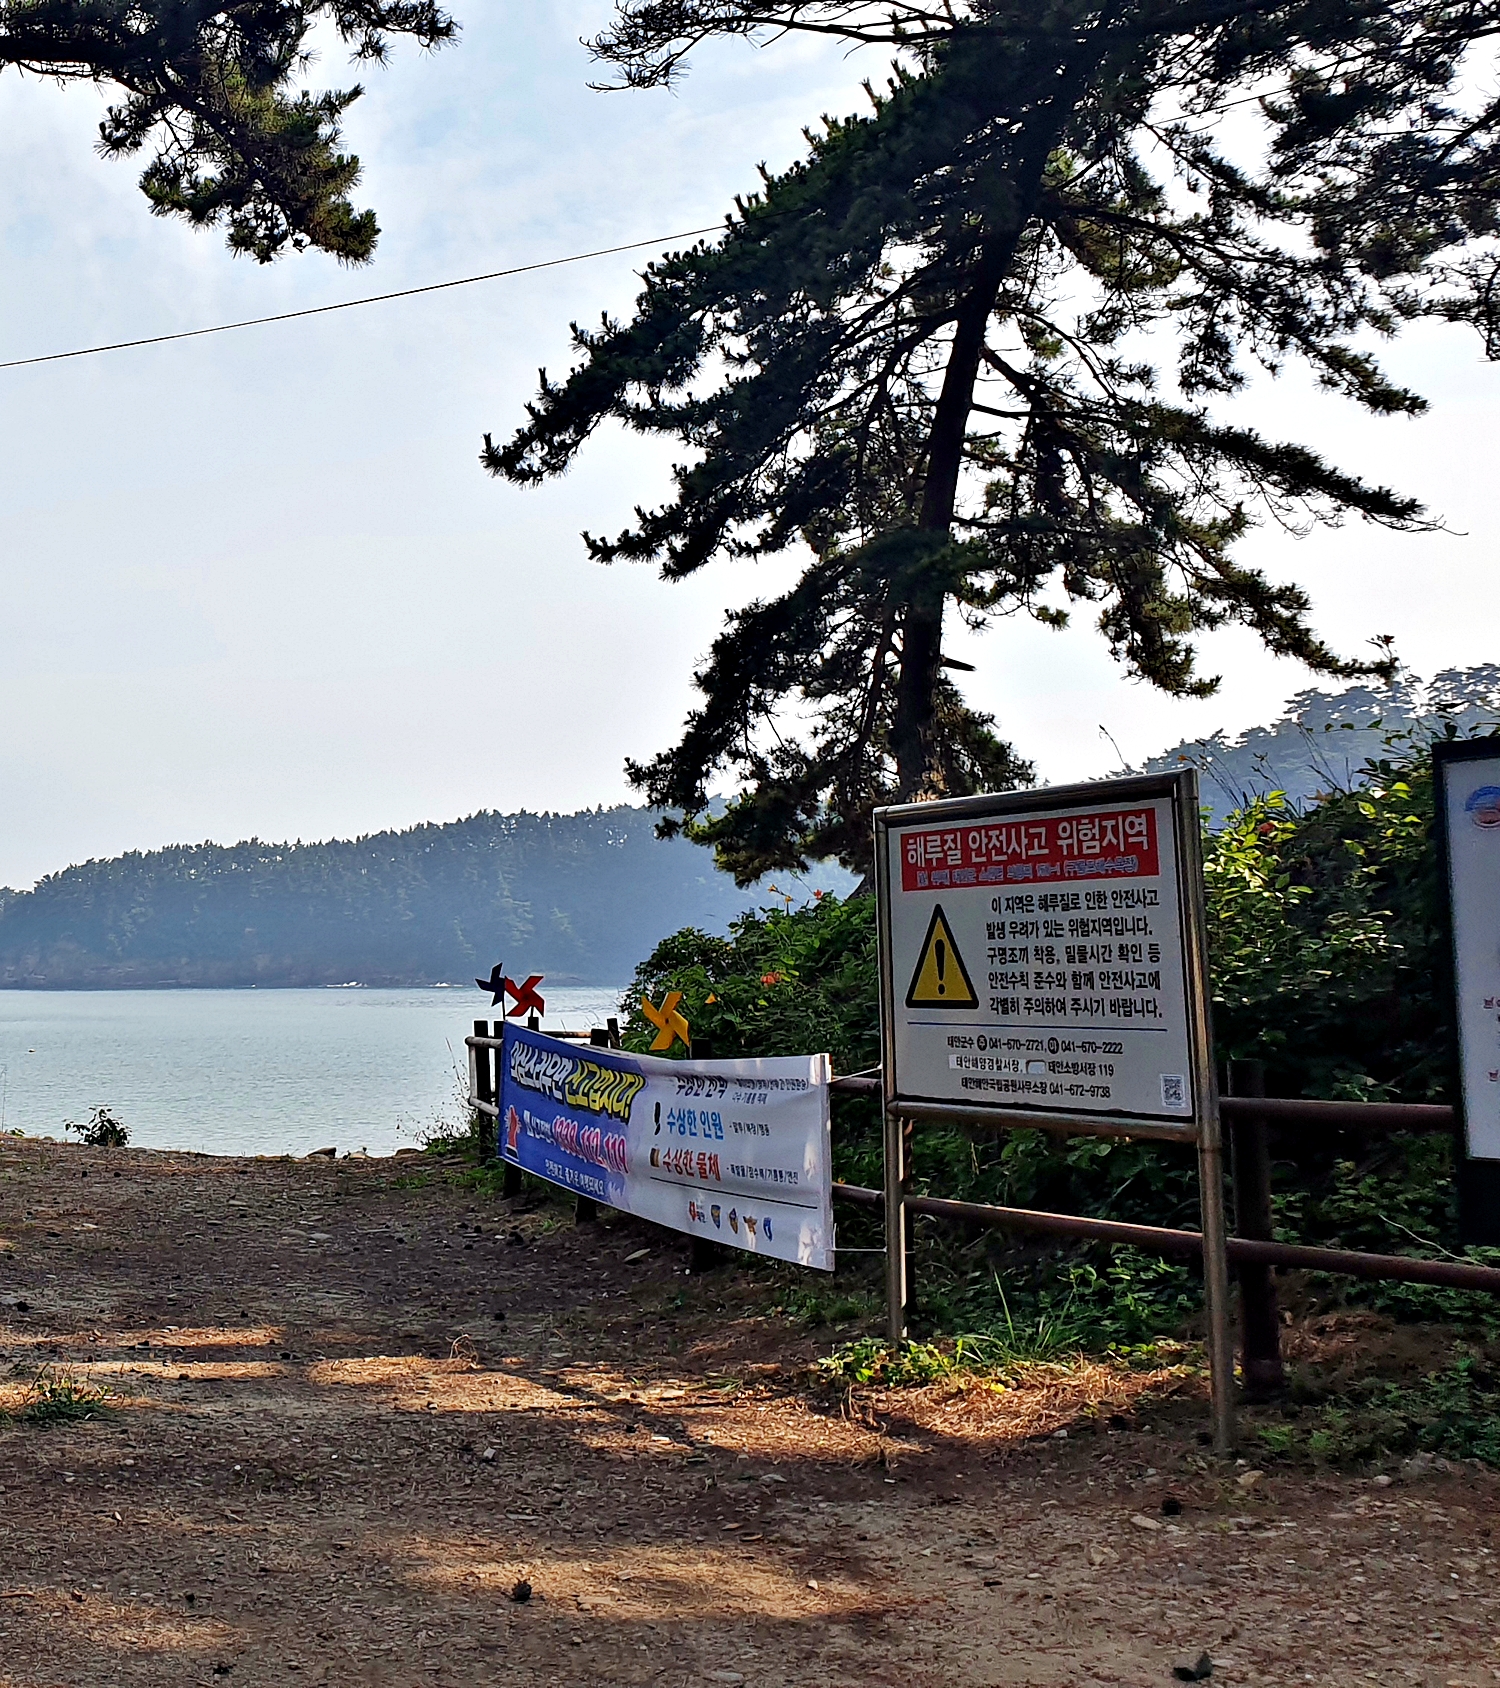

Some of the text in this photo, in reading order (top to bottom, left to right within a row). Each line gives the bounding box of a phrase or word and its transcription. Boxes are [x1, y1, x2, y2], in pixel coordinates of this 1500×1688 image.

[906, 813, 1148, 868] 해루질 안전사고 위험지역
[991, 896, 1001, 915] 이
[1004, 895, 1035, 914] 지역은
[1085, 890, 1108, 910] 인한
[1111, 888, 1160, 909] 안전사고
[986, 916, 1153, 940] 발생 우려가 있는 위험지역입니다.
[987, 946, 1029, 965] 구명조끼
[1033, 946, 1060, 965] 착용,
[1118, 943, 1143, 963] 확인
[1147, 943, 1161, 963] 등
[988, 970, 1161, 990] 안전수칙 준수와 함께 안전사고에
[990, 997, 1163, 1018] 각별히 주의하여 주시기 바랍니다.
[1048, 1060, 1096, 1077] 태안소방서장
[1099, 1063, 1114, 1077] 119
[1050, 1082, 1111, 1098] 041-672-9738
[667, 1107, 724, 1140] 수상한 인원
[663, 1147, 722, 1182] 수상한 물체
